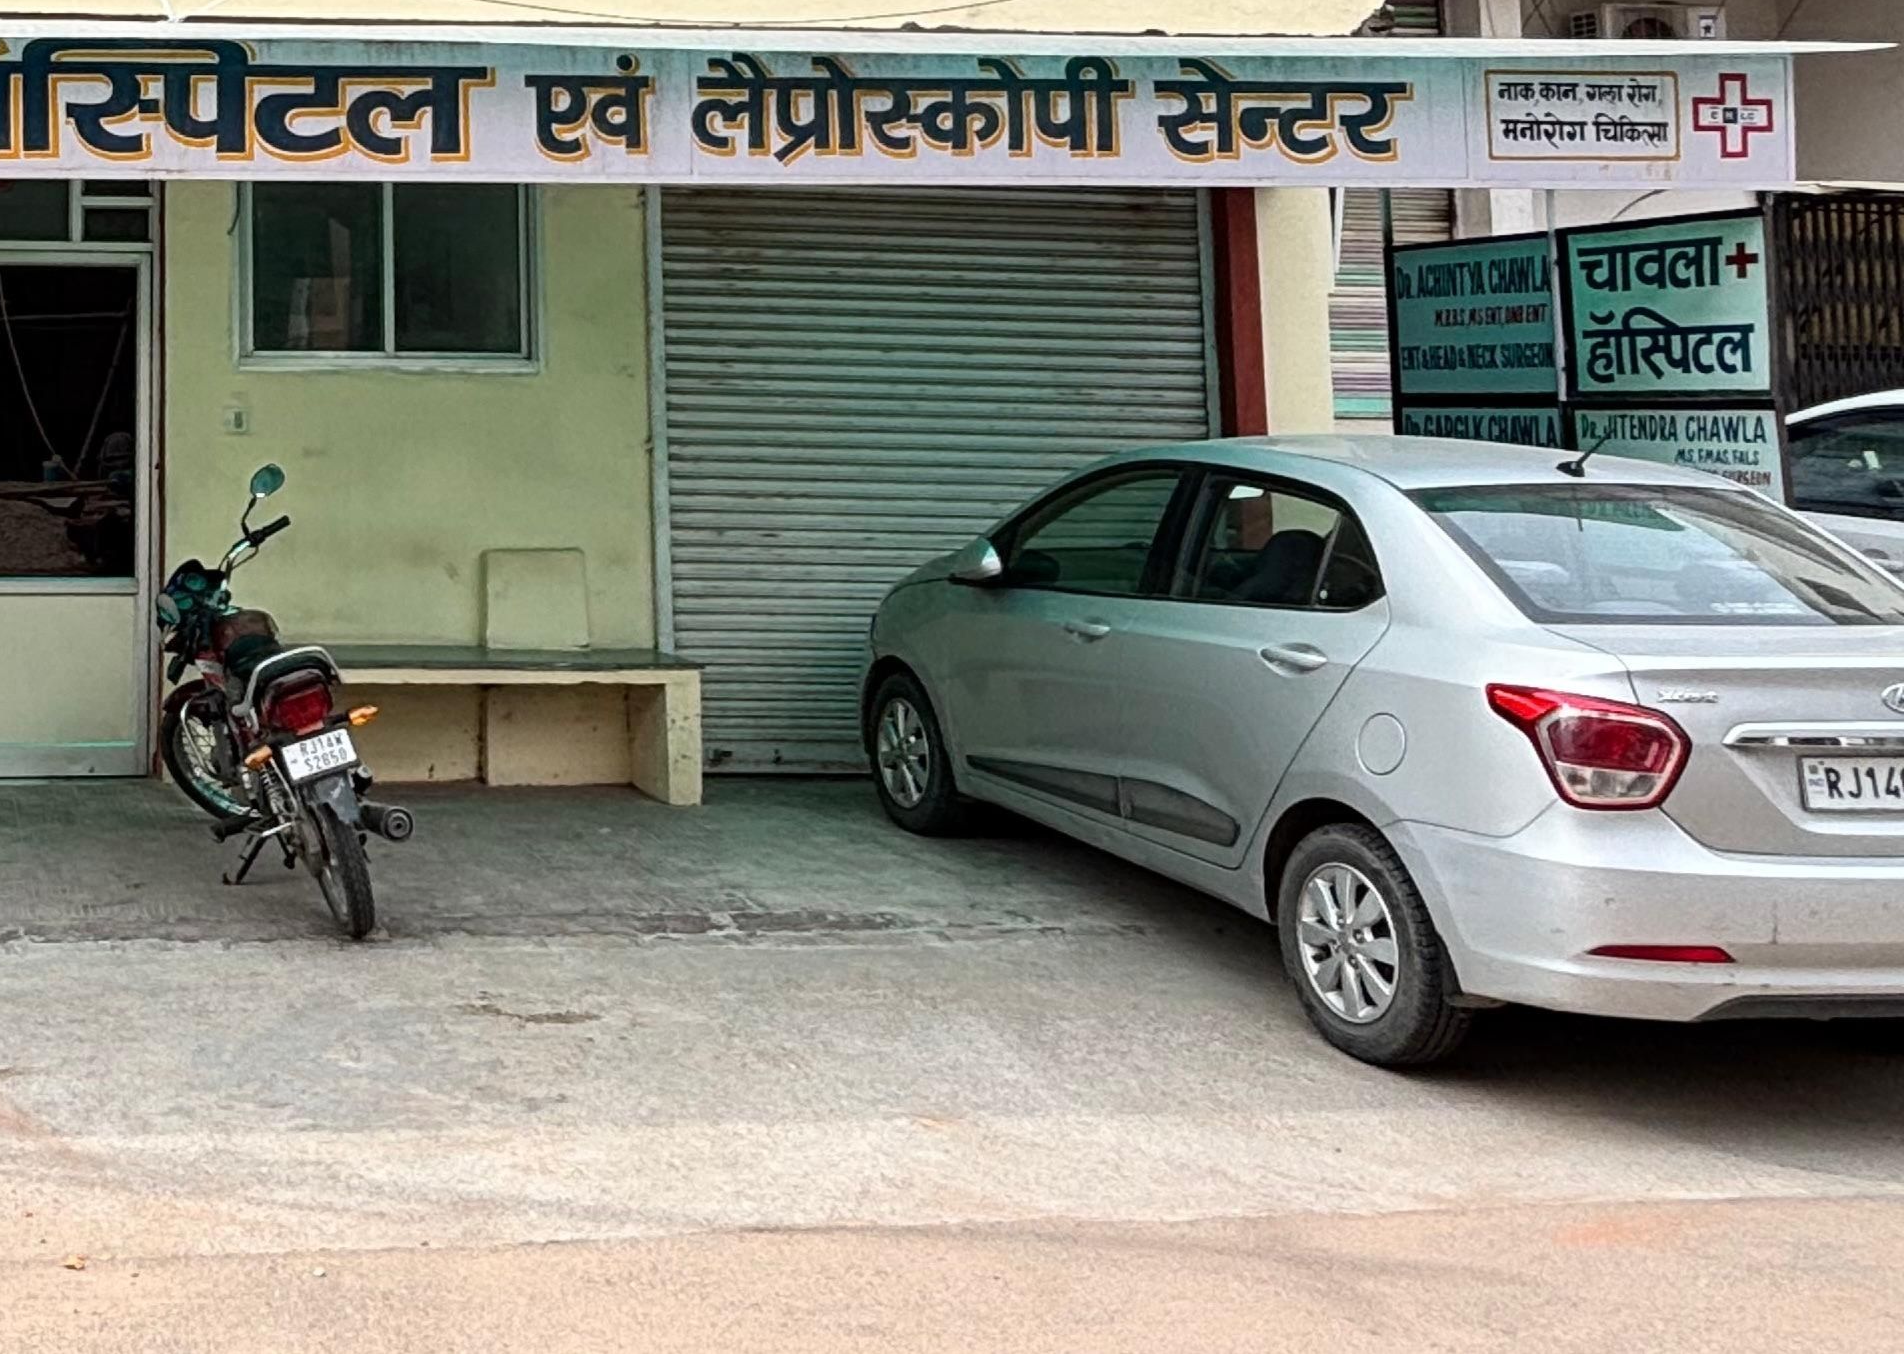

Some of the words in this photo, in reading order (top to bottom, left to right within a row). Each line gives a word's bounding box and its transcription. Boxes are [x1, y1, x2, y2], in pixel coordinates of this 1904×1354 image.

[524, 53, 656, 163] एवं
[691, 51, 1137, 168] लैप्रोस्कोपी
[1153, 55, 1414, 166] सेन्टर
[1500, 112, 1588, 149] मनोरोग
[1593, 113, 1669, 148] चिकित्सा
[1488, 255, 1552, 295] CHAWLA
[1577, 237, 1723, 292] चावला
[1582, 306, 1755, 384] हॉस्पिटल
[1685, 414, 1768, 444] CHAWLA
[1824, 767, 1904, 799] RJ14
